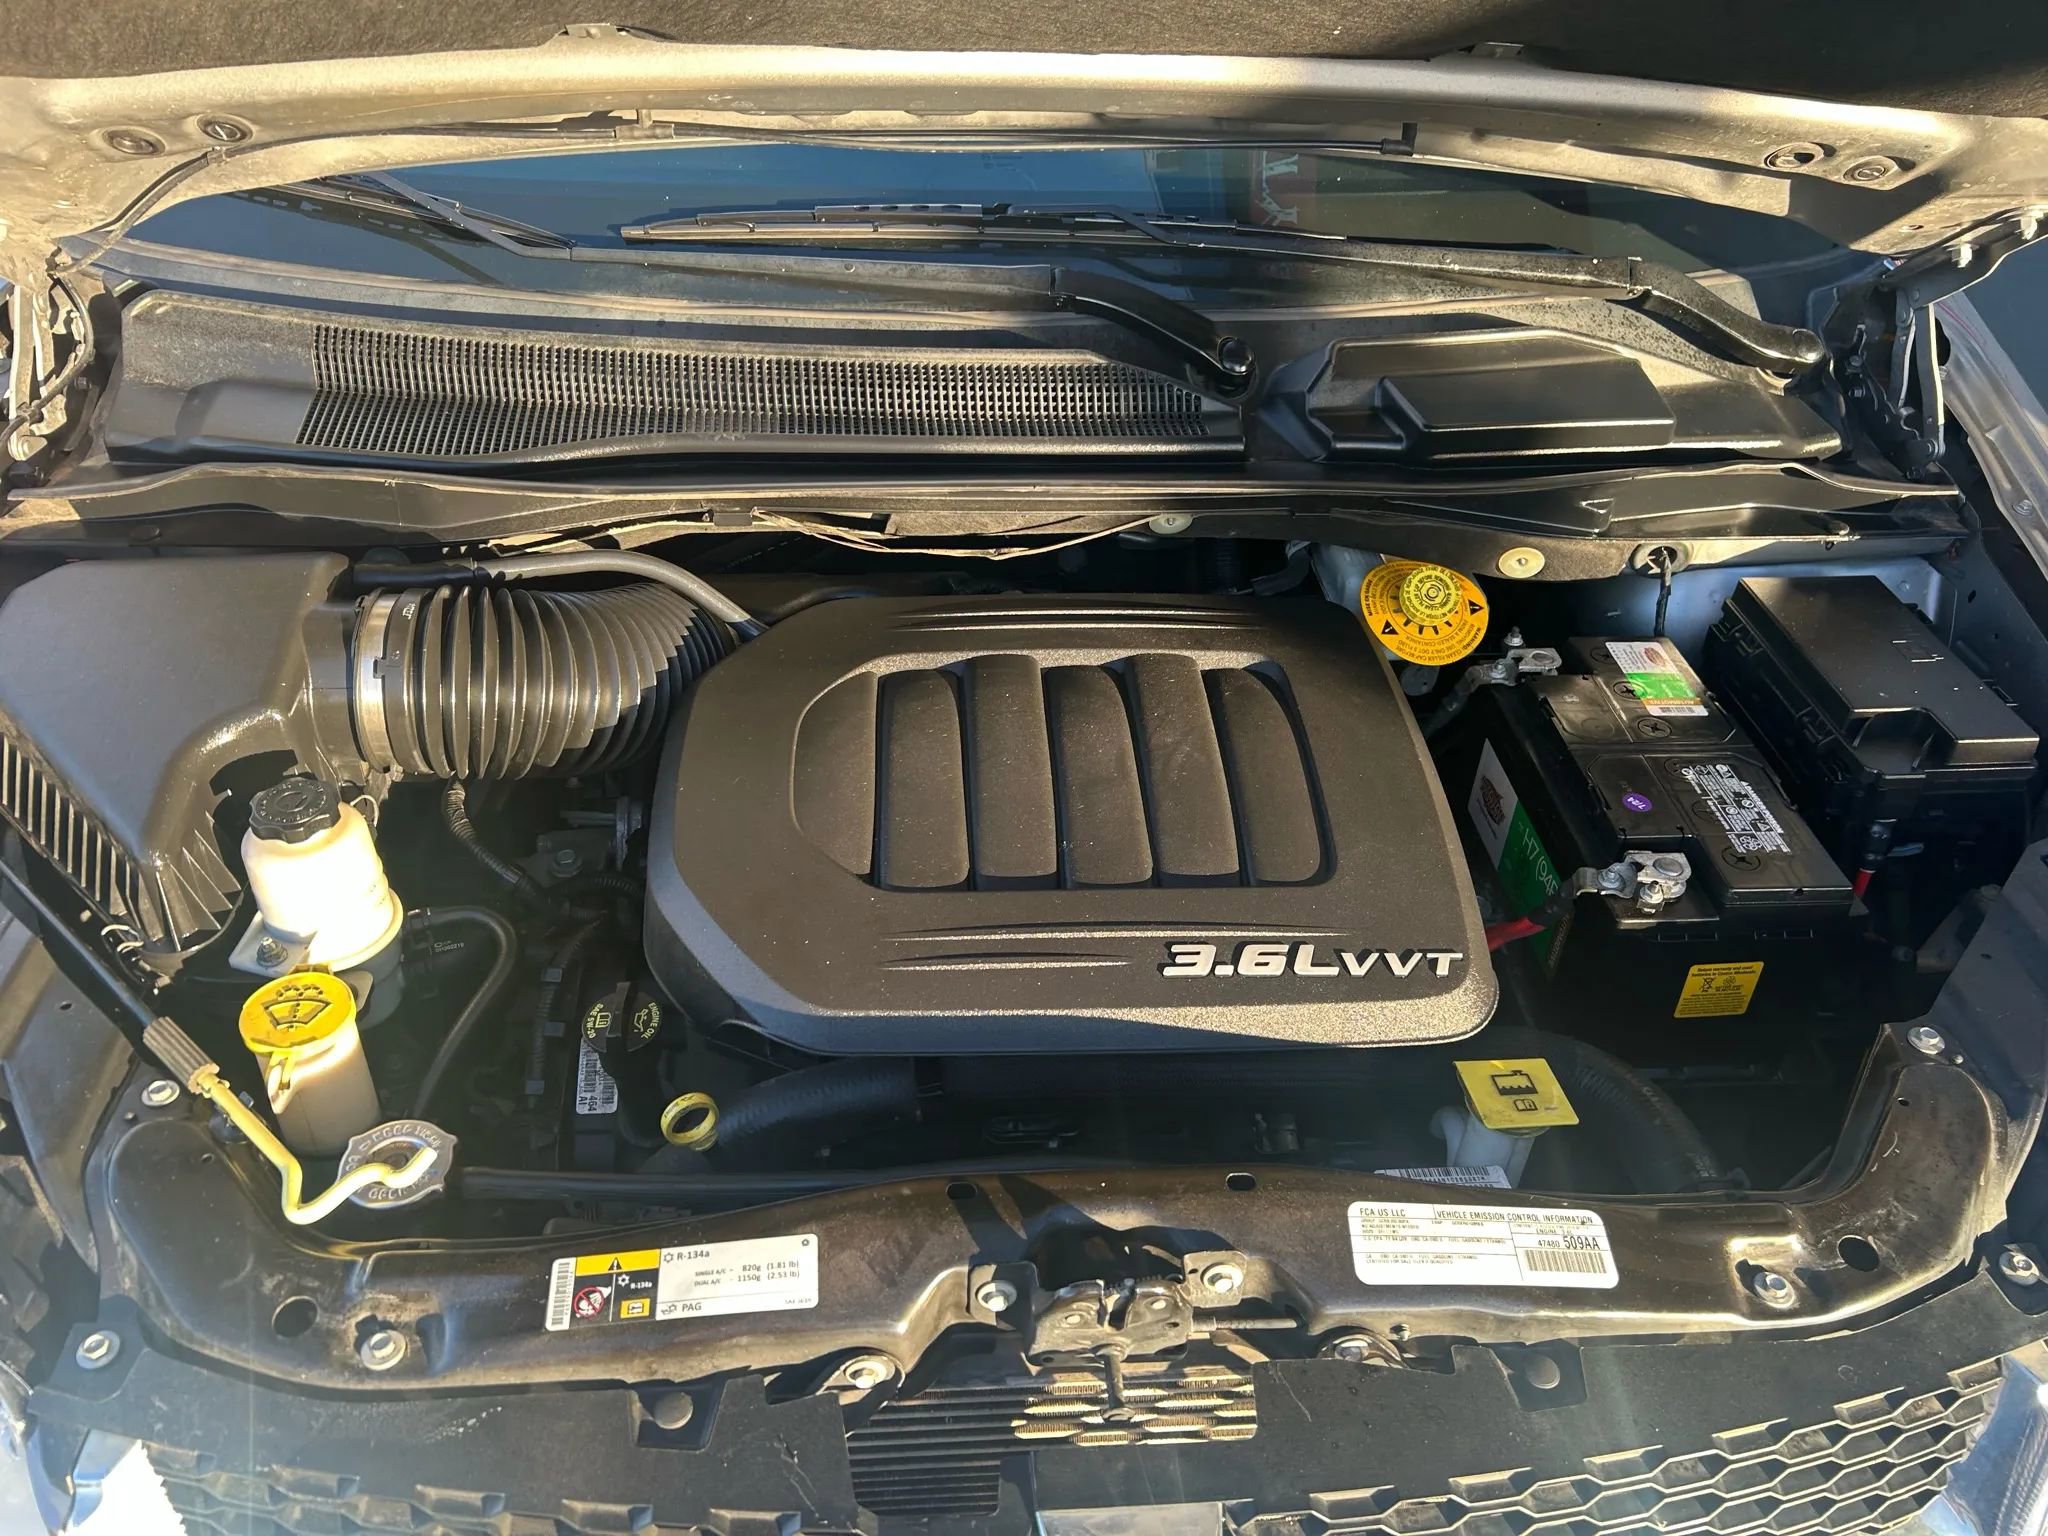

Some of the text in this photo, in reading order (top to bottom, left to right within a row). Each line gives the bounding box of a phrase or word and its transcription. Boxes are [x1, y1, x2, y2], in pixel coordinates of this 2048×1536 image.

[1162, 944, 1463, 977] 3.6L VVT
[586, 1003, 604, 1039] SAE 5W-20
[640, 1002, 660, 1040] ENGINE OIL
[587, 1095, 598, 1112] 464
[1360, 1208, 1406, 1217] FCA US LLC
[1437, 1210, 1593, 1224] VEHICLE EMISSION CONTROL INFORMATION
[1563, 1235, 1601, 1250] 509AA
[676, 1250, 710, 1261] R-134a
[742, 1264, 761, 1272] 820g
[766, 1261, 786, 1271] (1.81
[789, 1259, 799, 1268] lb)
[710, 1278, 721, 1286] A/C
[738, 1274, 761, 1282] 1150g
[789, 1270, 800, 1278] lb)
[682, 1303, 702, 1312] PAG
